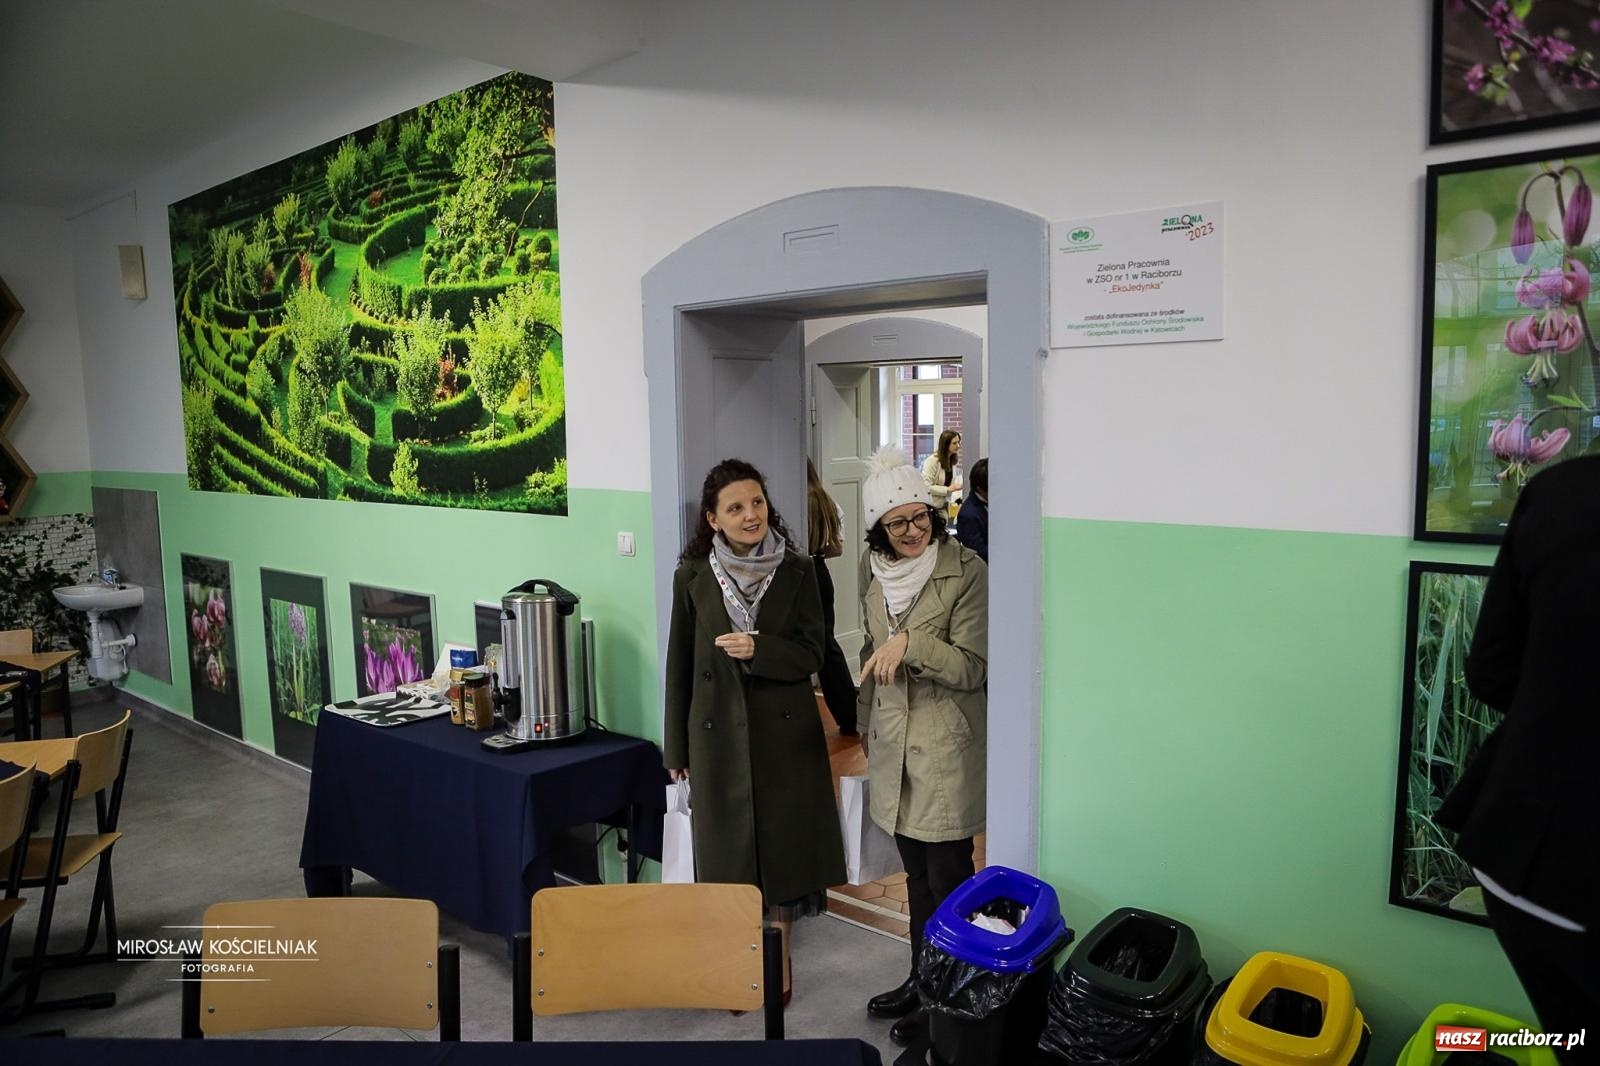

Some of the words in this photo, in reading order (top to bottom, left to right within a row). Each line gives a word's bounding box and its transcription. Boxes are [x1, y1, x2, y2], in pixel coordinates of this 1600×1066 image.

[1097, 264, 1126, 272] Zielona
[1127, 258, 1170, 269] Pracownia
[1095, 274, 1112, 284] ZSO
[1141, 269, 1183, 279] Raciborzu
[1105, 311, 1149, 320] dofinansowana
